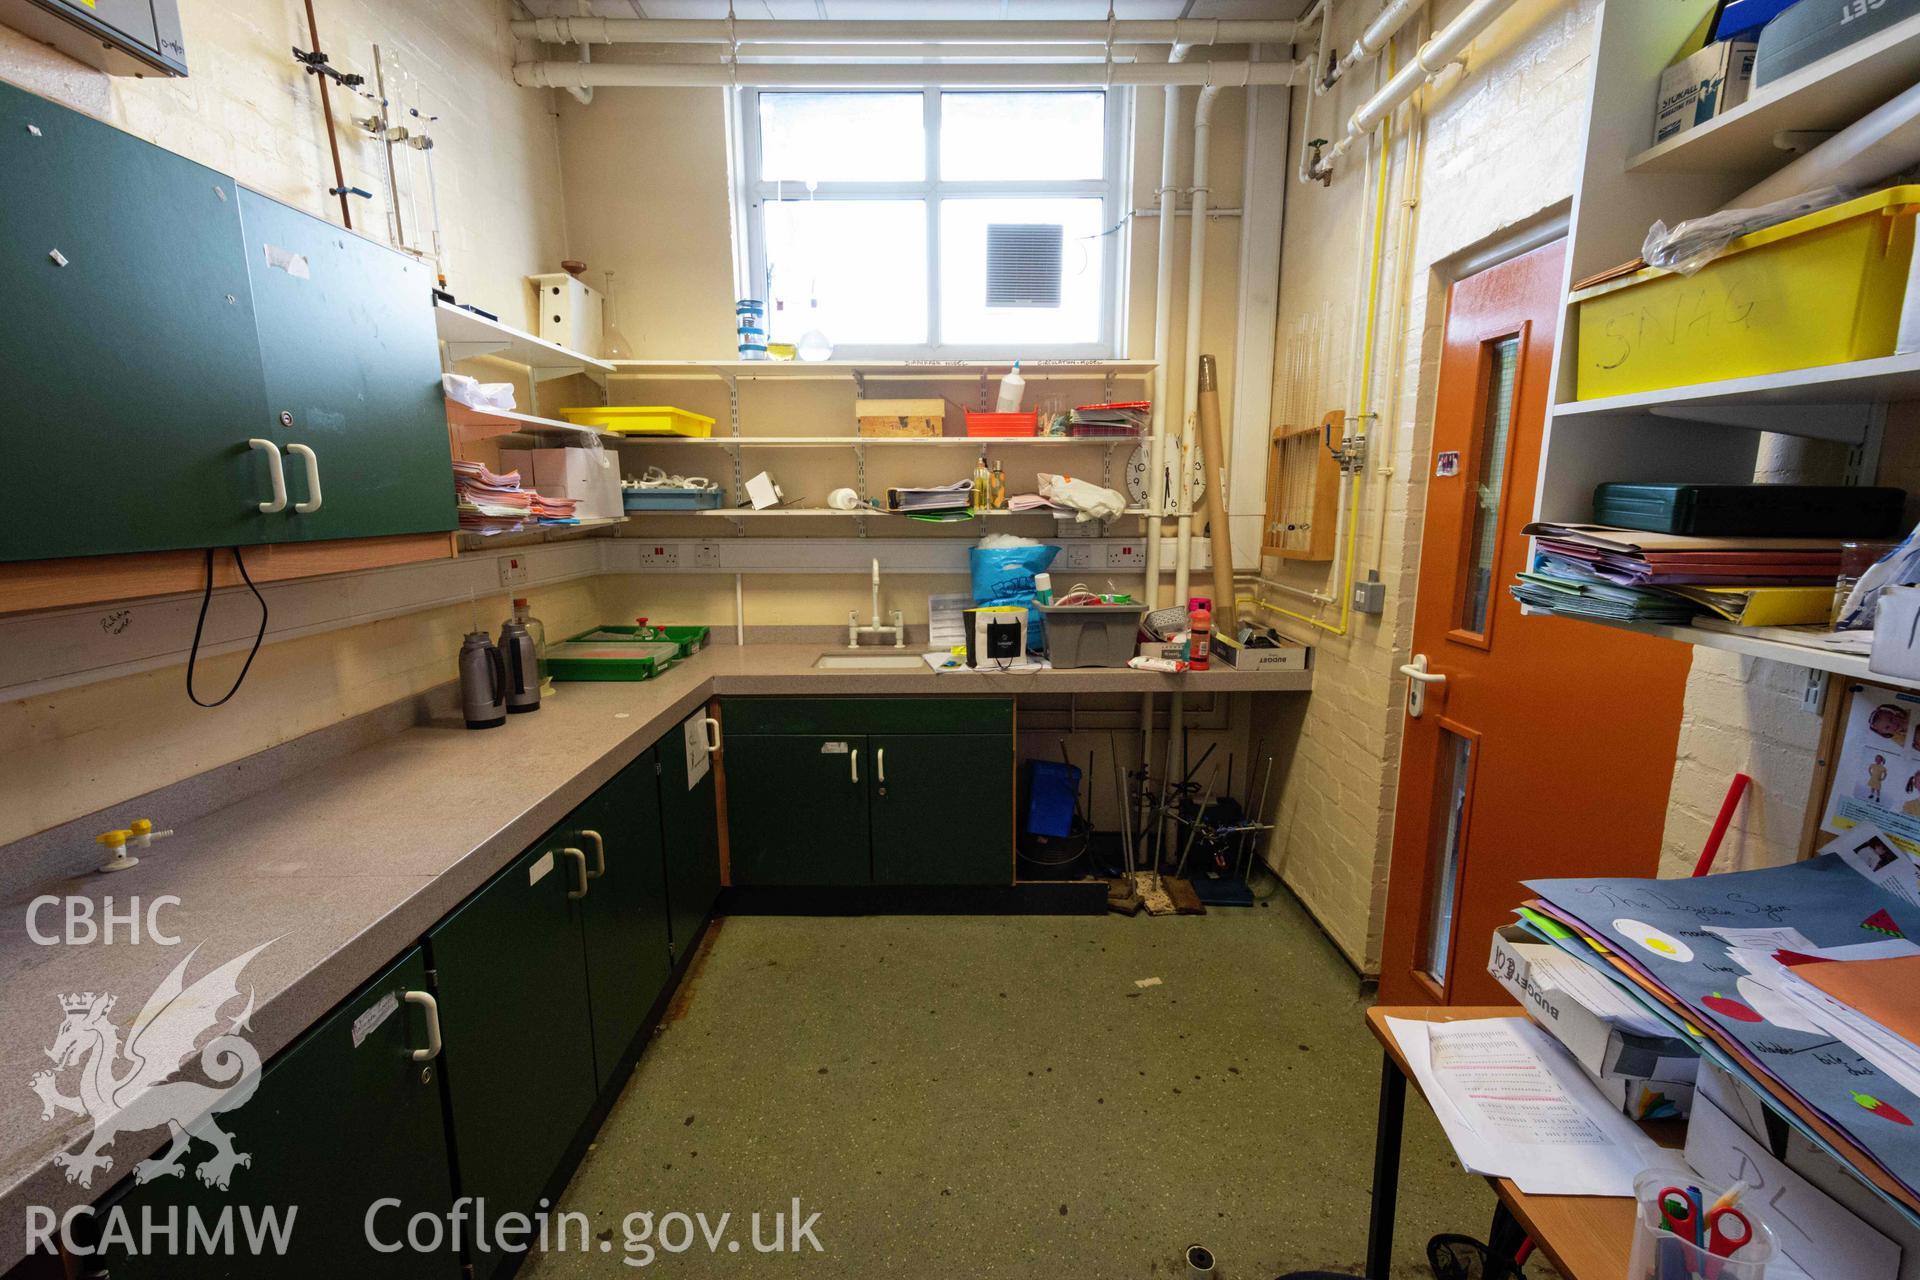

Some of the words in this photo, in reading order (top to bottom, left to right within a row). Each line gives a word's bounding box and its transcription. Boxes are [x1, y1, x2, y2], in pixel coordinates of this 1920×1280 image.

[1134, 463, 1146, 473] 10
[1194, 462, 1202, 471] 3
[1133, 477, 1140, 486] 9
[1193, 478, 1200, 486] 4
[1141, 491, 1148, 499] 8
[1170, 499, 1177, 508] 6
[1259, 656, 1287, 664] BUDGET
[1514, 973, 1560, 1021] BUDGET
